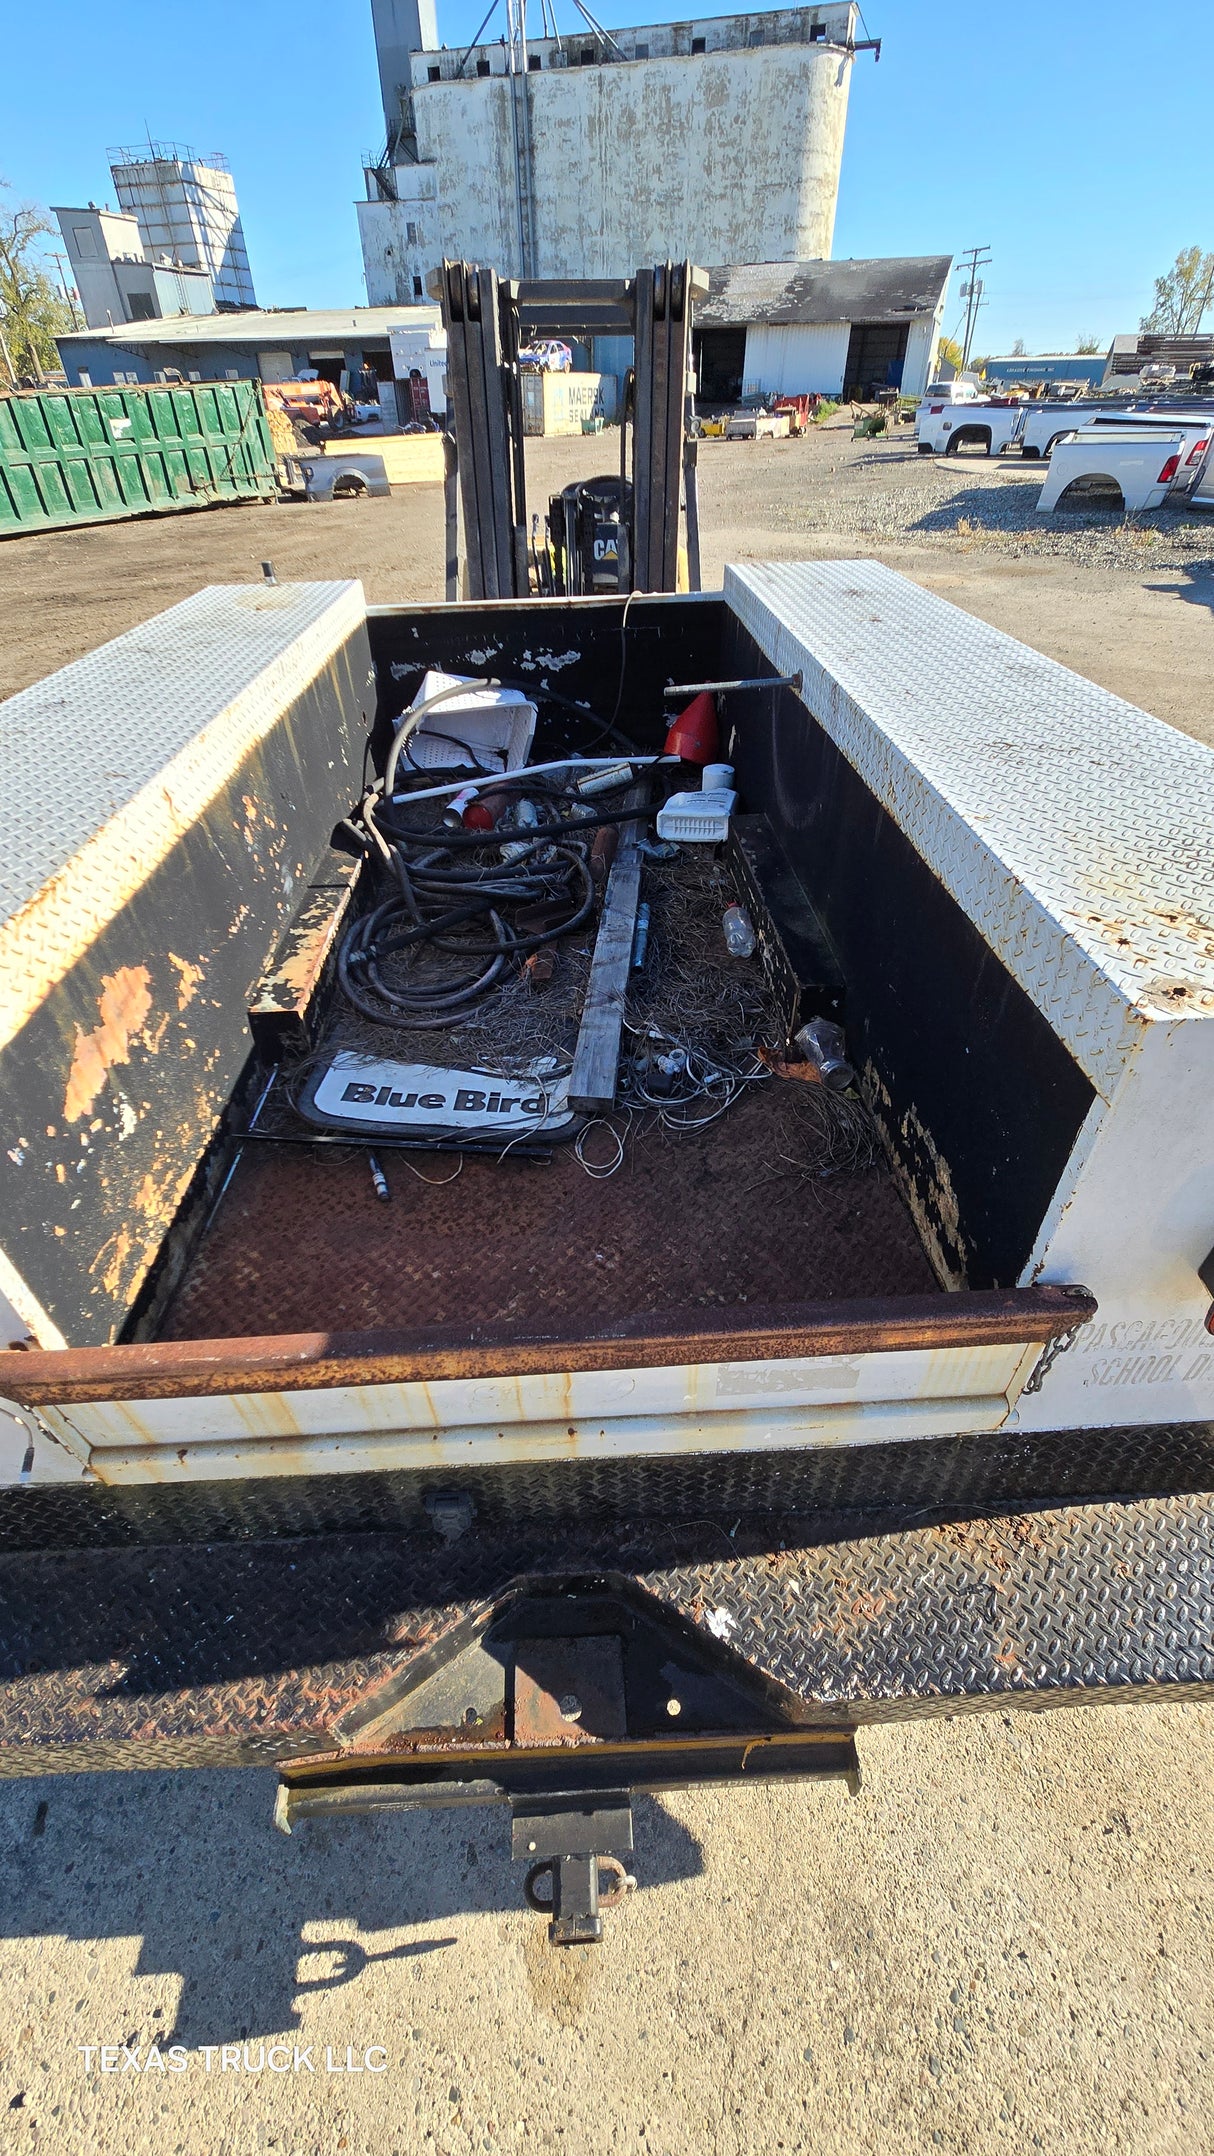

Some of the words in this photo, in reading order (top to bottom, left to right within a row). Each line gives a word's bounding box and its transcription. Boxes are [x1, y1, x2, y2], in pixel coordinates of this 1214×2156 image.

[569, 386, 604, 405] MAERSK
[593, 539, 618, 560] CA
[340, 1082, 447, 1109] Blue
[453, 1089, 550, 1113] Bird
[1090, 1355, 1183, 1386] SCHOOL
